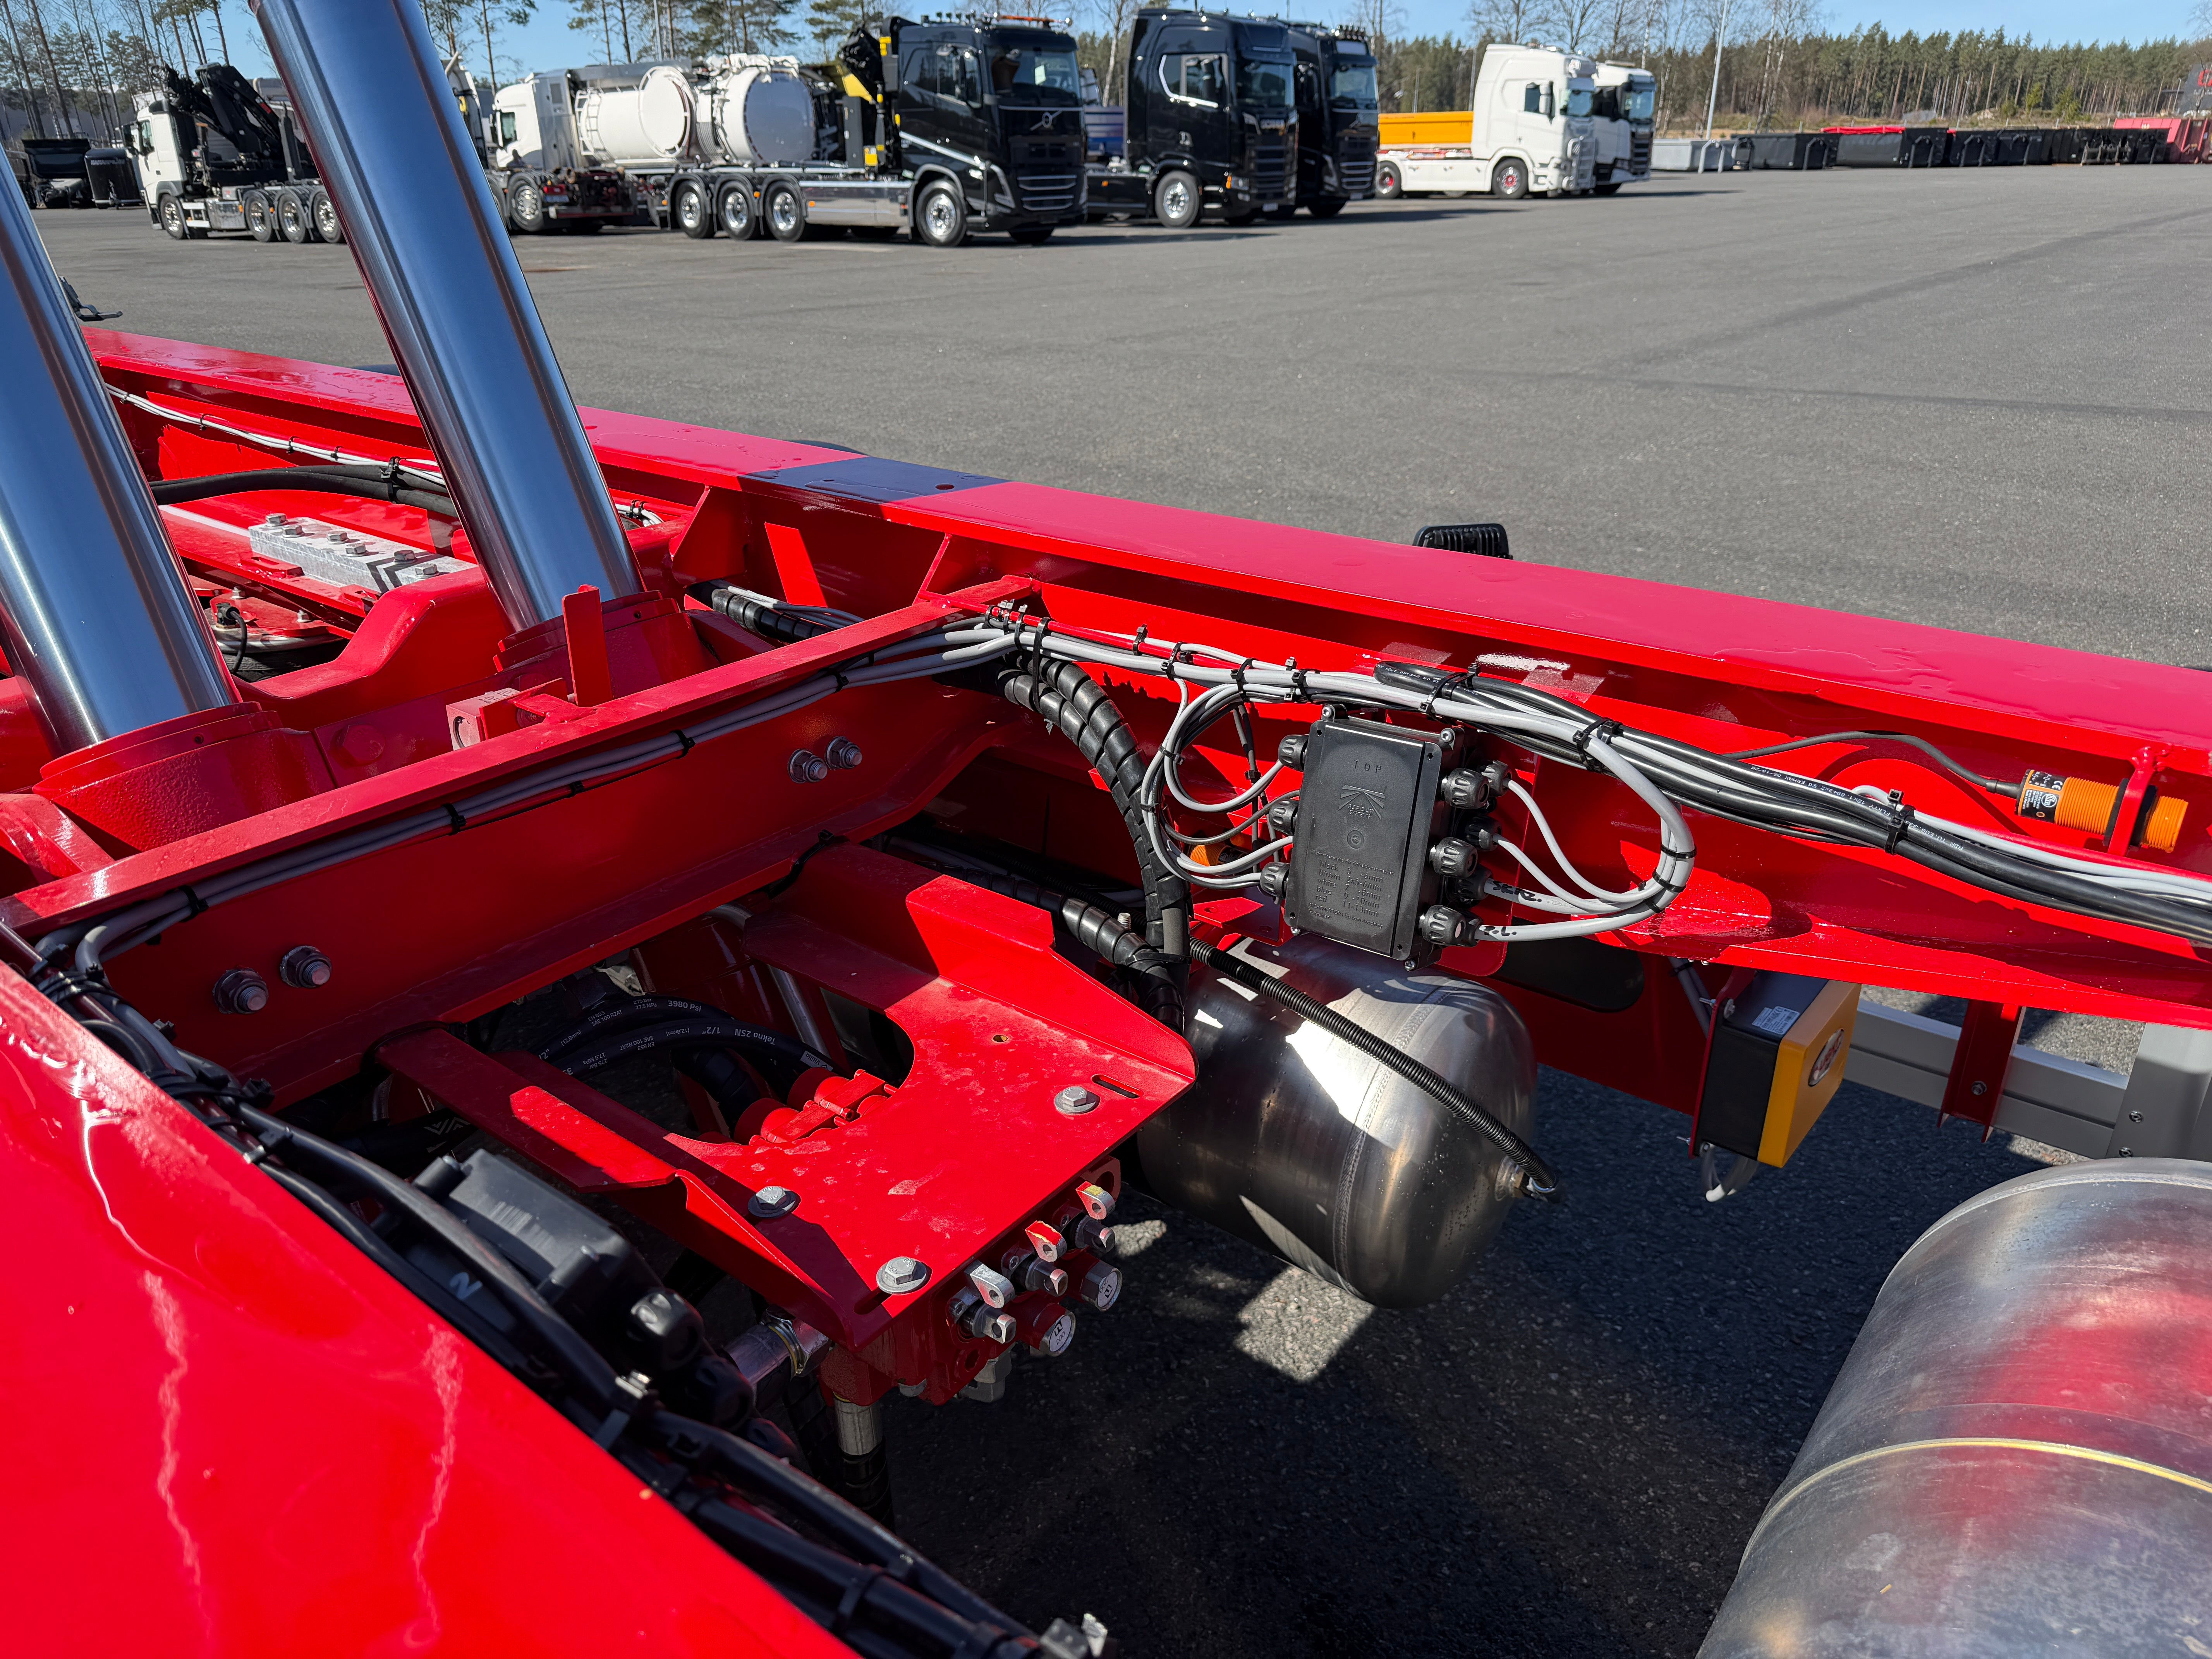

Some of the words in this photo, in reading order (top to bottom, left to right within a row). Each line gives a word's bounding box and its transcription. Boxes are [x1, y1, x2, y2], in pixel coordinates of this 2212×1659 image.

[1354, 760, 1382, 773] TOP
[1784, 776, 1806, 785] ERMAX
[1869, 804, 1891, 816] FLRYY
[1949, 842, 1964, 850] ADR
[1320, 859, 1338, 872] black
[1317, 878, 1336, 888] white
[1317, 885, 1332, 895] blue
[668, 1000, 688, 1008] 3980
[690, 1003, 701, 1012] Psi
[611, 1010, 623, 1018] R2AT
[735, 1028, 751, 1037] 2SN
[754, 1032, 775, 1045] Tekno
[620, 1041, 634, 1051] R2AT
[582, 1056, 594, 1065] MPa
[598, 1058, 608, 1066] 275
[805, 1052, 820, 1066] Vitillo
[1099, 1279, 1109, 1293] 200
[1055, 1331, 1066, 1346] 200
